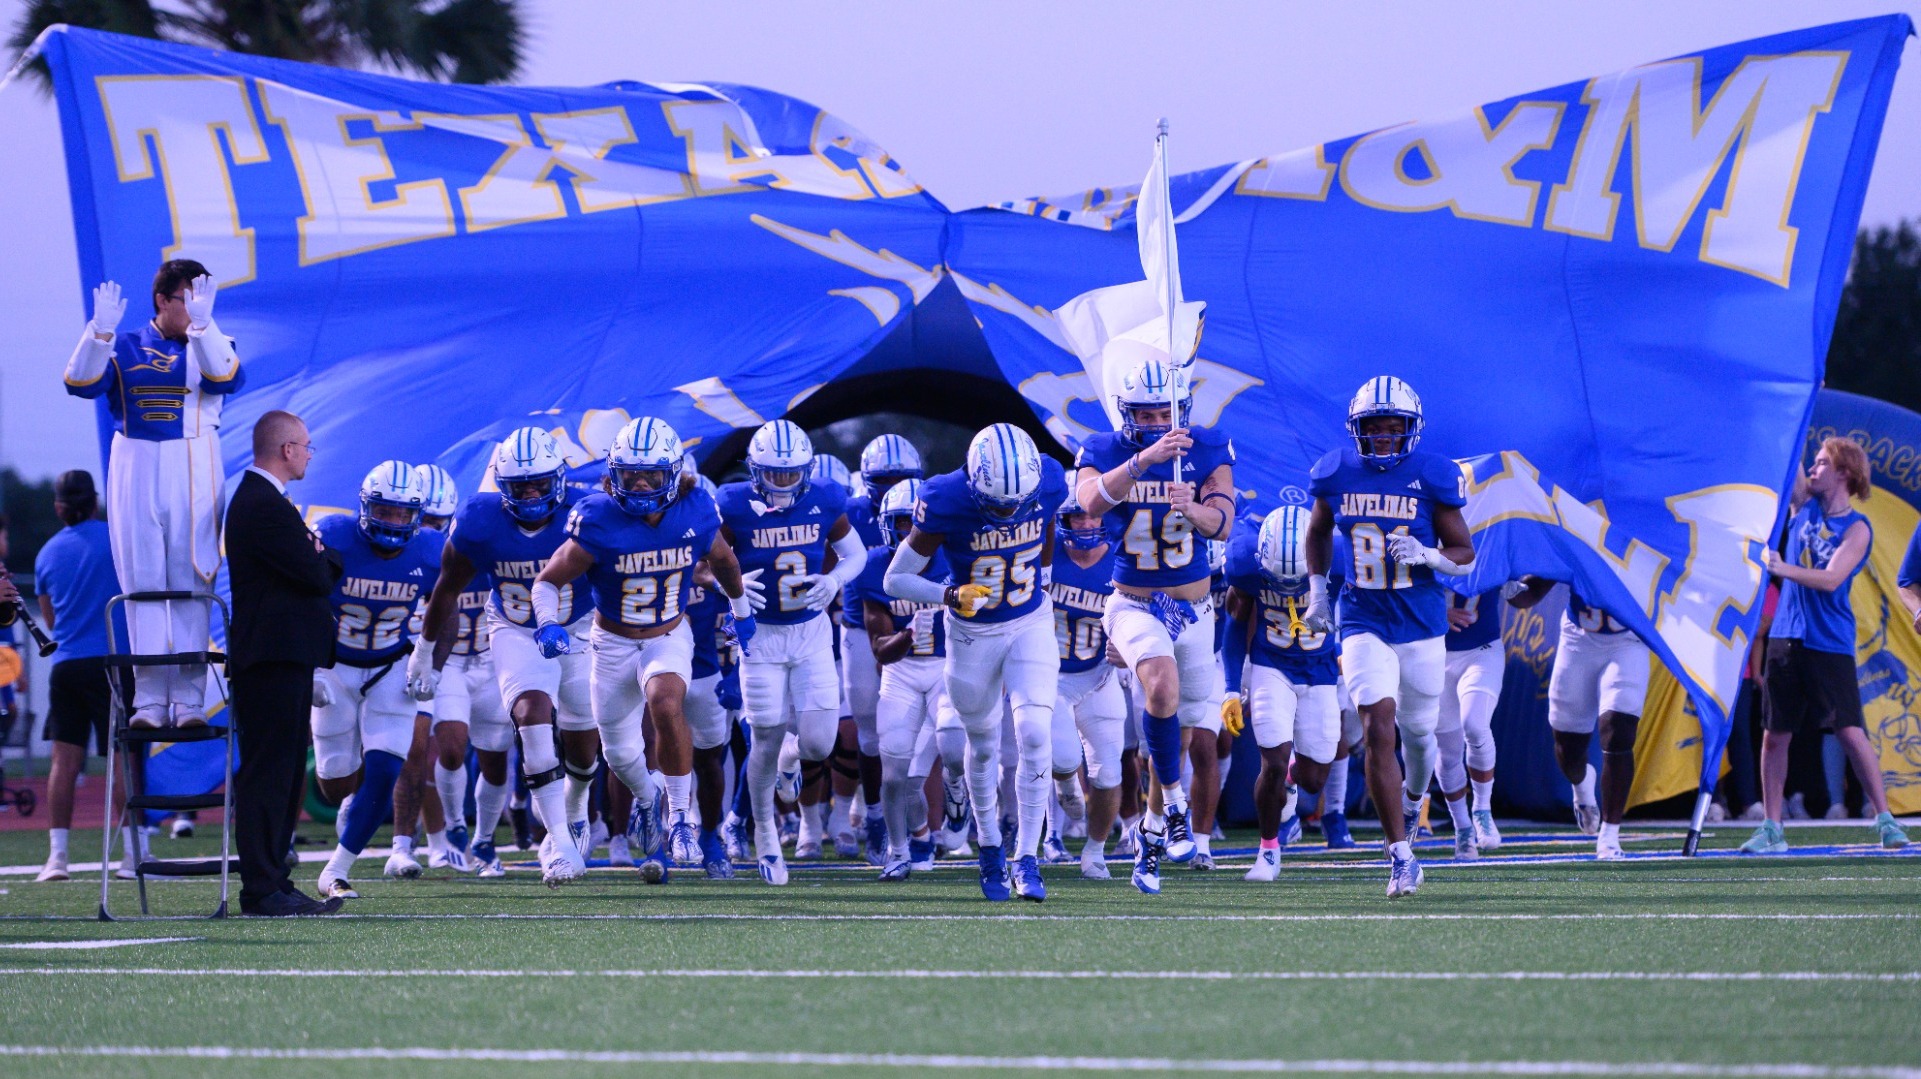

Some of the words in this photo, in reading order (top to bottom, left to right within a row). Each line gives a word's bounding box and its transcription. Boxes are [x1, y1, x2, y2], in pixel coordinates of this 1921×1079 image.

[1340, 493, 1418, 520] JAVELINAS
[751, 524, 820, 549] JAVELINAS
[970, 517, 1043, 551] JAVELINAS
[1123, 508, 1194, 570] 49
[615, 546, 693, 574] JAVELINAS
[1351, 522, 1413, 590] 81
[341, 577, 419, 602] JAVELINAS
[620, 571, 684, 625] 21
[774, 550, 809, 612] 2
[337, 603, 409, 651] 22
